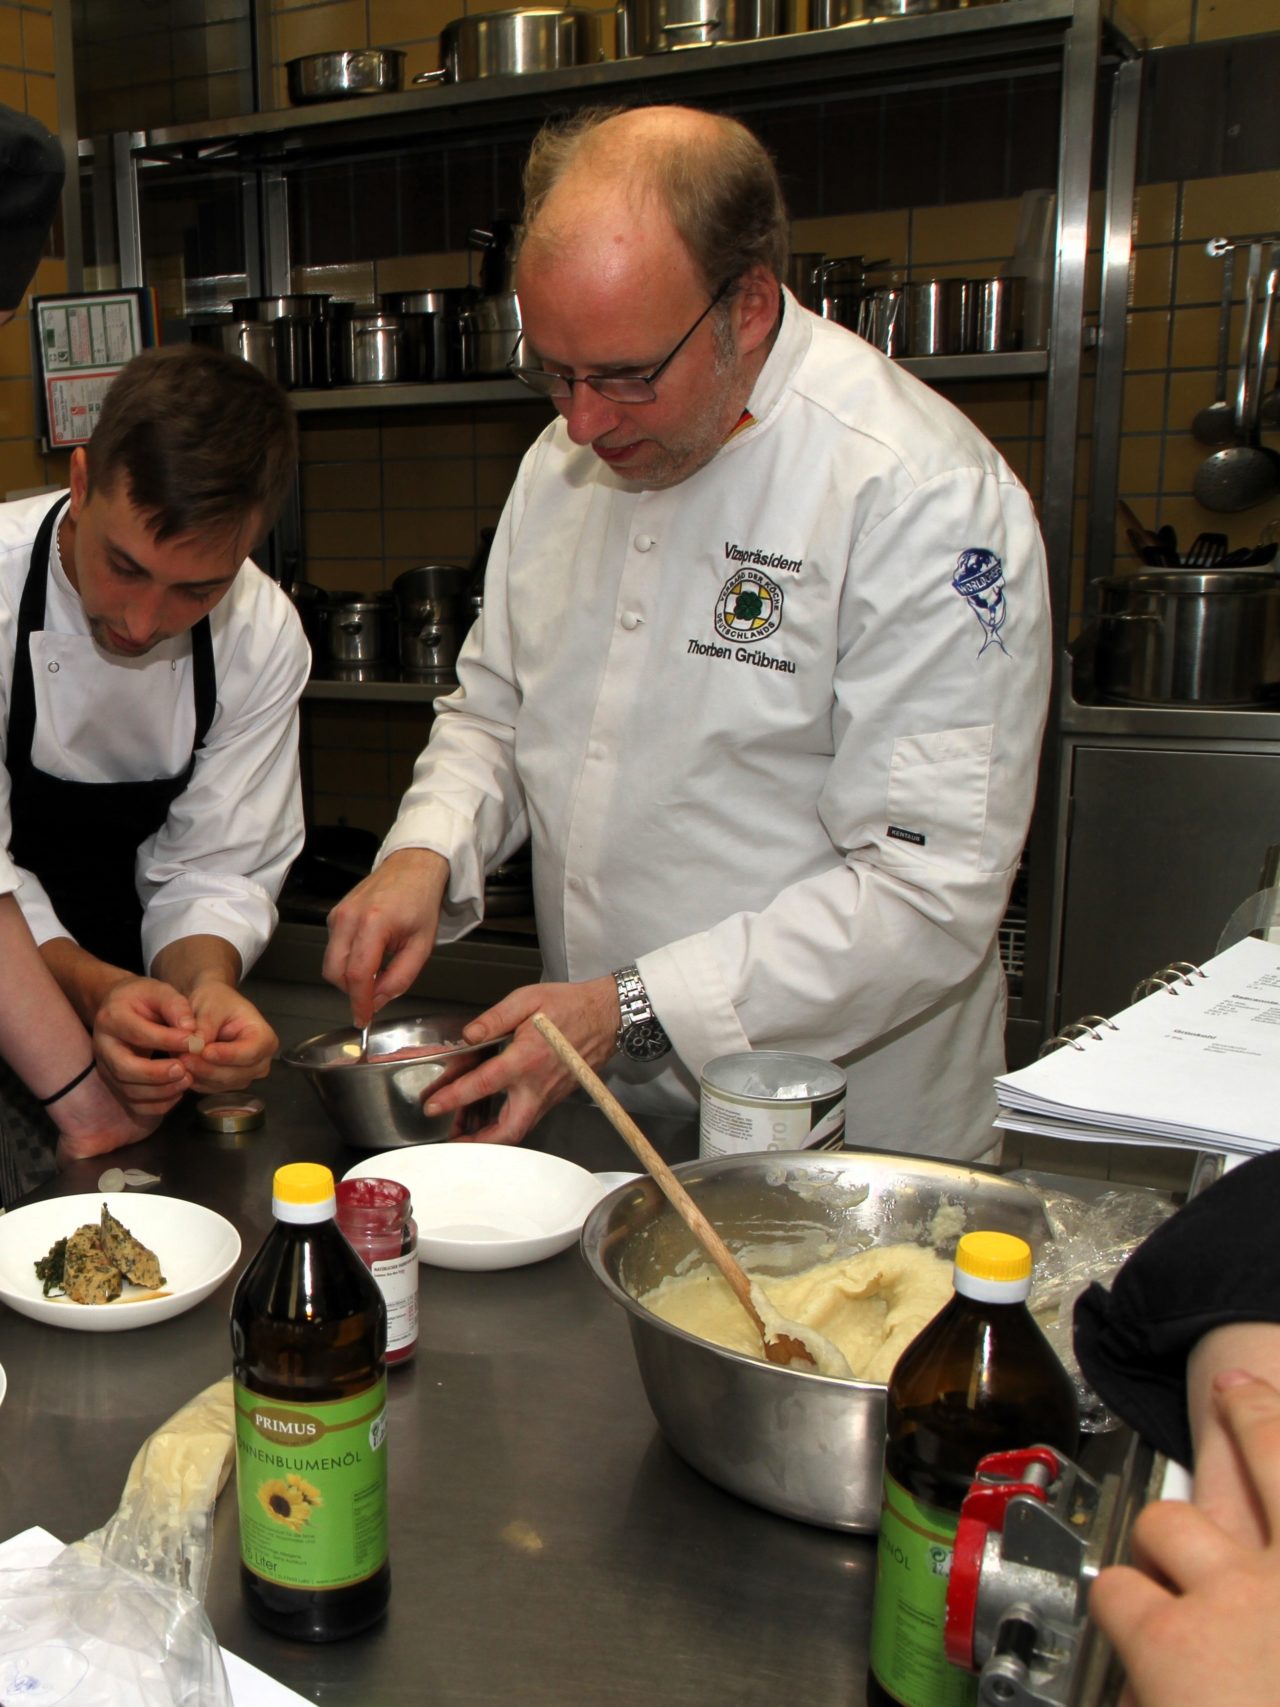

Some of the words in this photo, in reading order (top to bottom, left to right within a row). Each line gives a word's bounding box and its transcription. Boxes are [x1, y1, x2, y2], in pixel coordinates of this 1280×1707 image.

[748, 572, 764, 583] DER
[764, 582, 781, 611] KÖCHE
[717, 613, 776, 640] DEUTSCHLANDS
[687, 639, 732, 660] Thorben
[735, 647, 796, 674] Grübnau
[255, 1413, 317, 1435] PRIMUS
[255, 1553, 278, 1572] Liter
